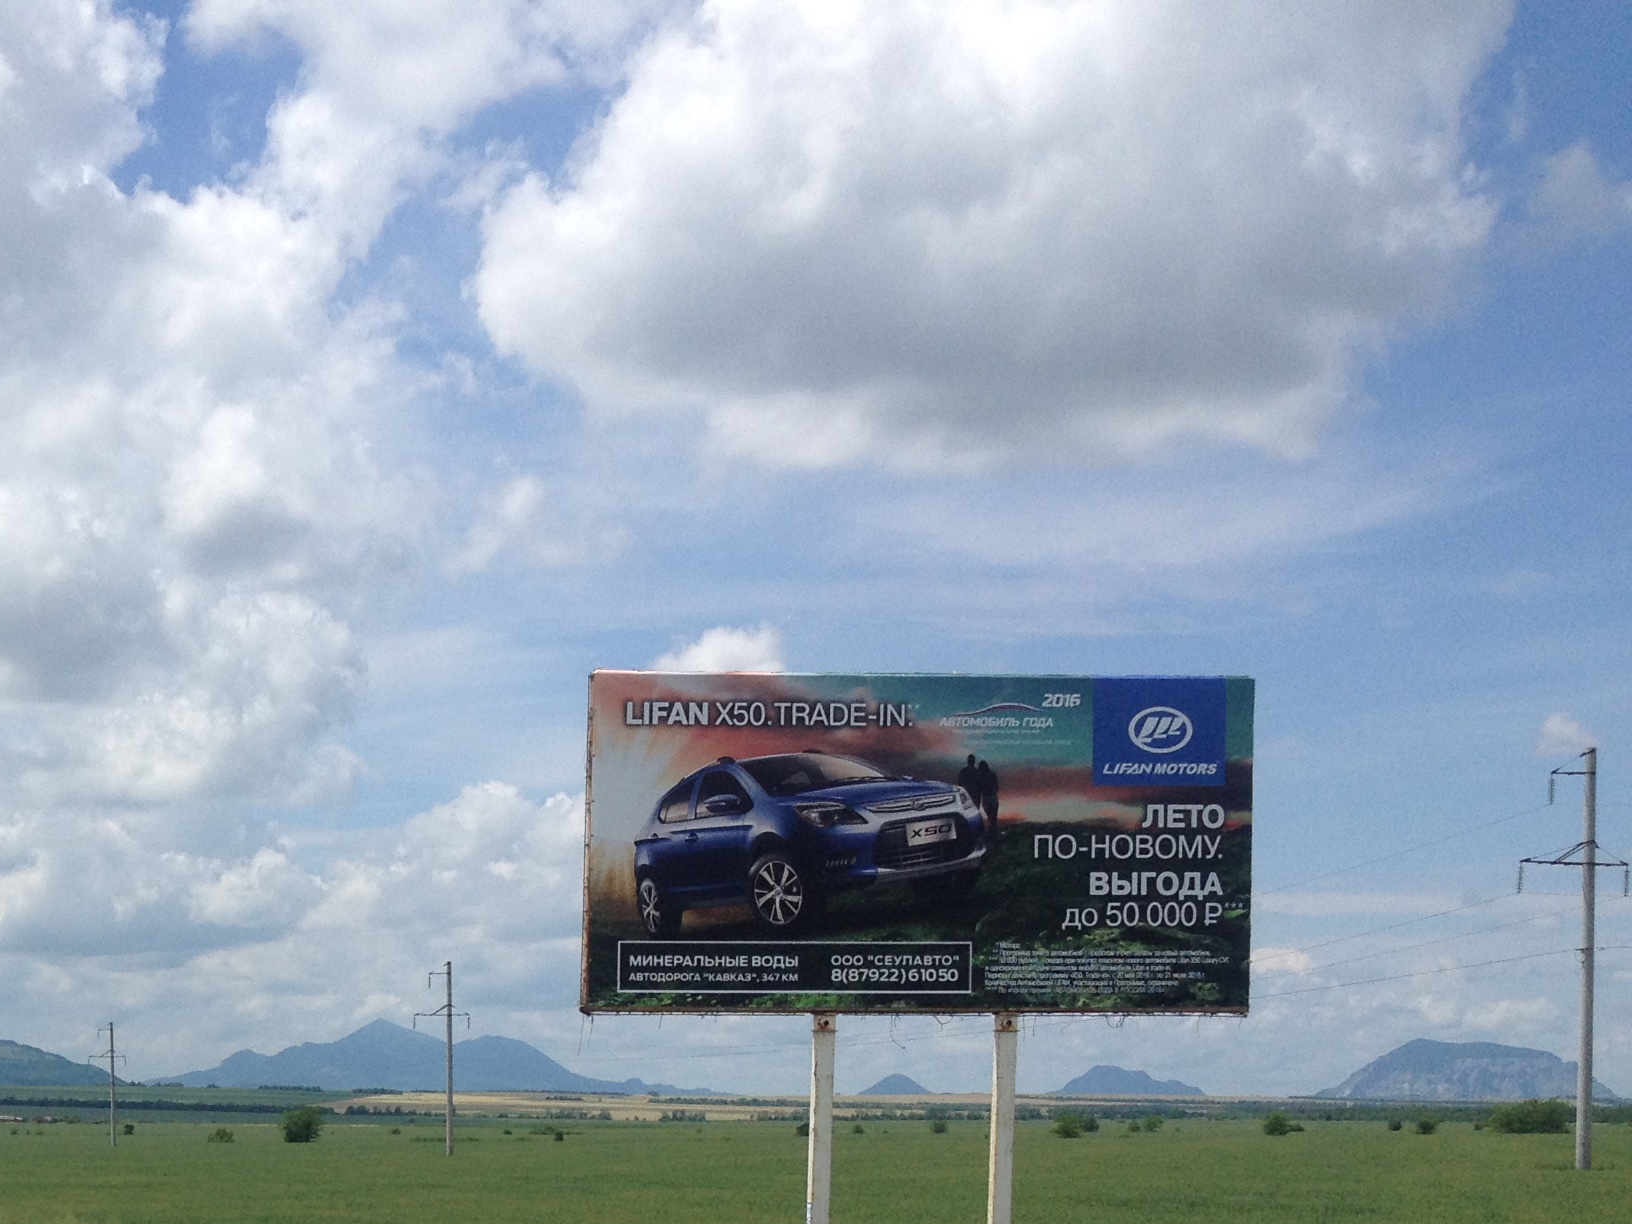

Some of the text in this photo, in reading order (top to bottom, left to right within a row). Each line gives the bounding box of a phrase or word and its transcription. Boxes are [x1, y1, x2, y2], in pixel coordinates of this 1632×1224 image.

[1042, 694, 1081, 708] 2016
[626, 702, 709, 725] LIFAN
[939, 717, 1054, 729] АВТОМОБИЛЬ ГОДА
[1103, 763, 1217, 775] LIFAN MOTORS
[1142, 804, 1225, 828] ЛЕТО
[911, 823, 952, 838] X50
[1034, 834, 1223, 859] ПО-НОВОМУ.
[1089, 871, 1223, 900] ВЫГОДА
[1062, 908, 1098, 930] до
[1106, 902, 1139, 926] 50
[1146, 902, 1196, 926] 000
[629, 955, 799, 969] МИНЕРАЛЬНЫЕ ВОДЫ
[831, 955, 960, 966] ООО "СЕУЛАВТО"
[628, 972, 701, 982] АВТОДОРОГА
[761, 973, 779, 982] 347
[782, 973, 799, 982] КМ
